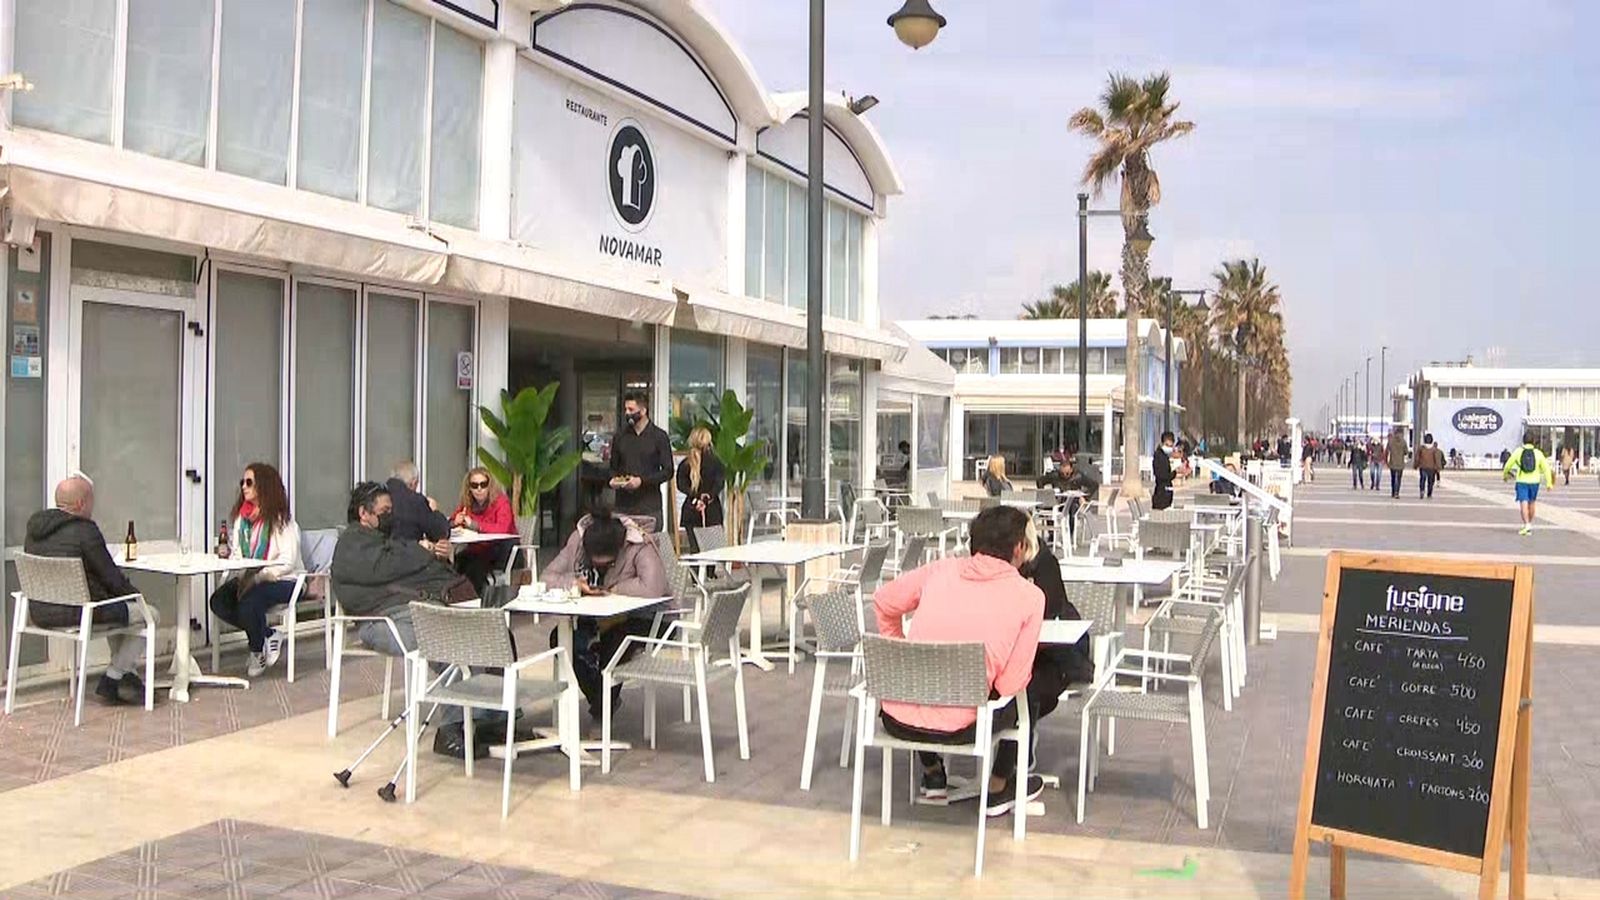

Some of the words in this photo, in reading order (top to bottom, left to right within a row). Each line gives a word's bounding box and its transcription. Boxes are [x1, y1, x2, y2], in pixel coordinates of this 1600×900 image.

[566, 98, 608, 127] RESTAURANTE
[599, 234, 662, 267] NOVAMAR
[1386, 585, 1464, 612] fusione
[1365, 614, 1453, 635] MERIENDAS
[1406, 647, 1440, 660] TARTA
[1401, 682, 1437, 695] GOFRE
[1399, 714, 1440, 728] CREPES
[1396, 747, 1456, 765] CROISSANT
[1337, 770, 1395, 789] HORCHATA
[1421, 782, 1465, 800] FARTONS
